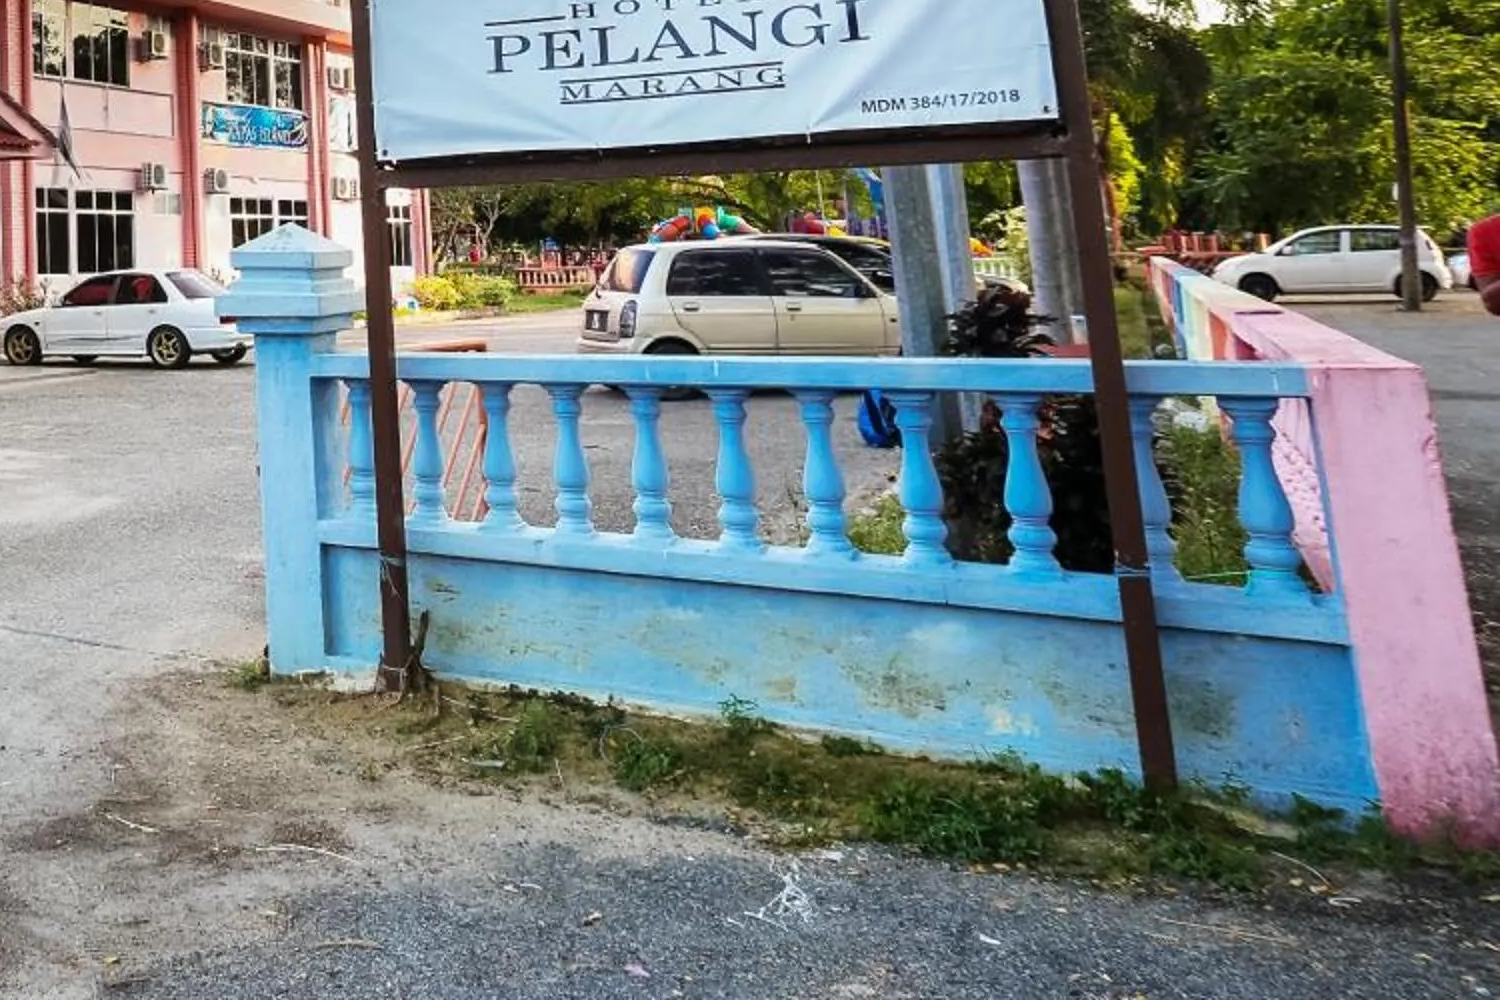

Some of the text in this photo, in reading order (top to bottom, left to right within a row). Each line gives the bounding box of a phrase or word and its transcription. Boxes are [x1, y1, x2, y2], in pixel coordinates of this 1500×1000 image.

[560, 65, 787, 101] MARANG
[861, 87, 1021, 114] MDM 384/17/2018
